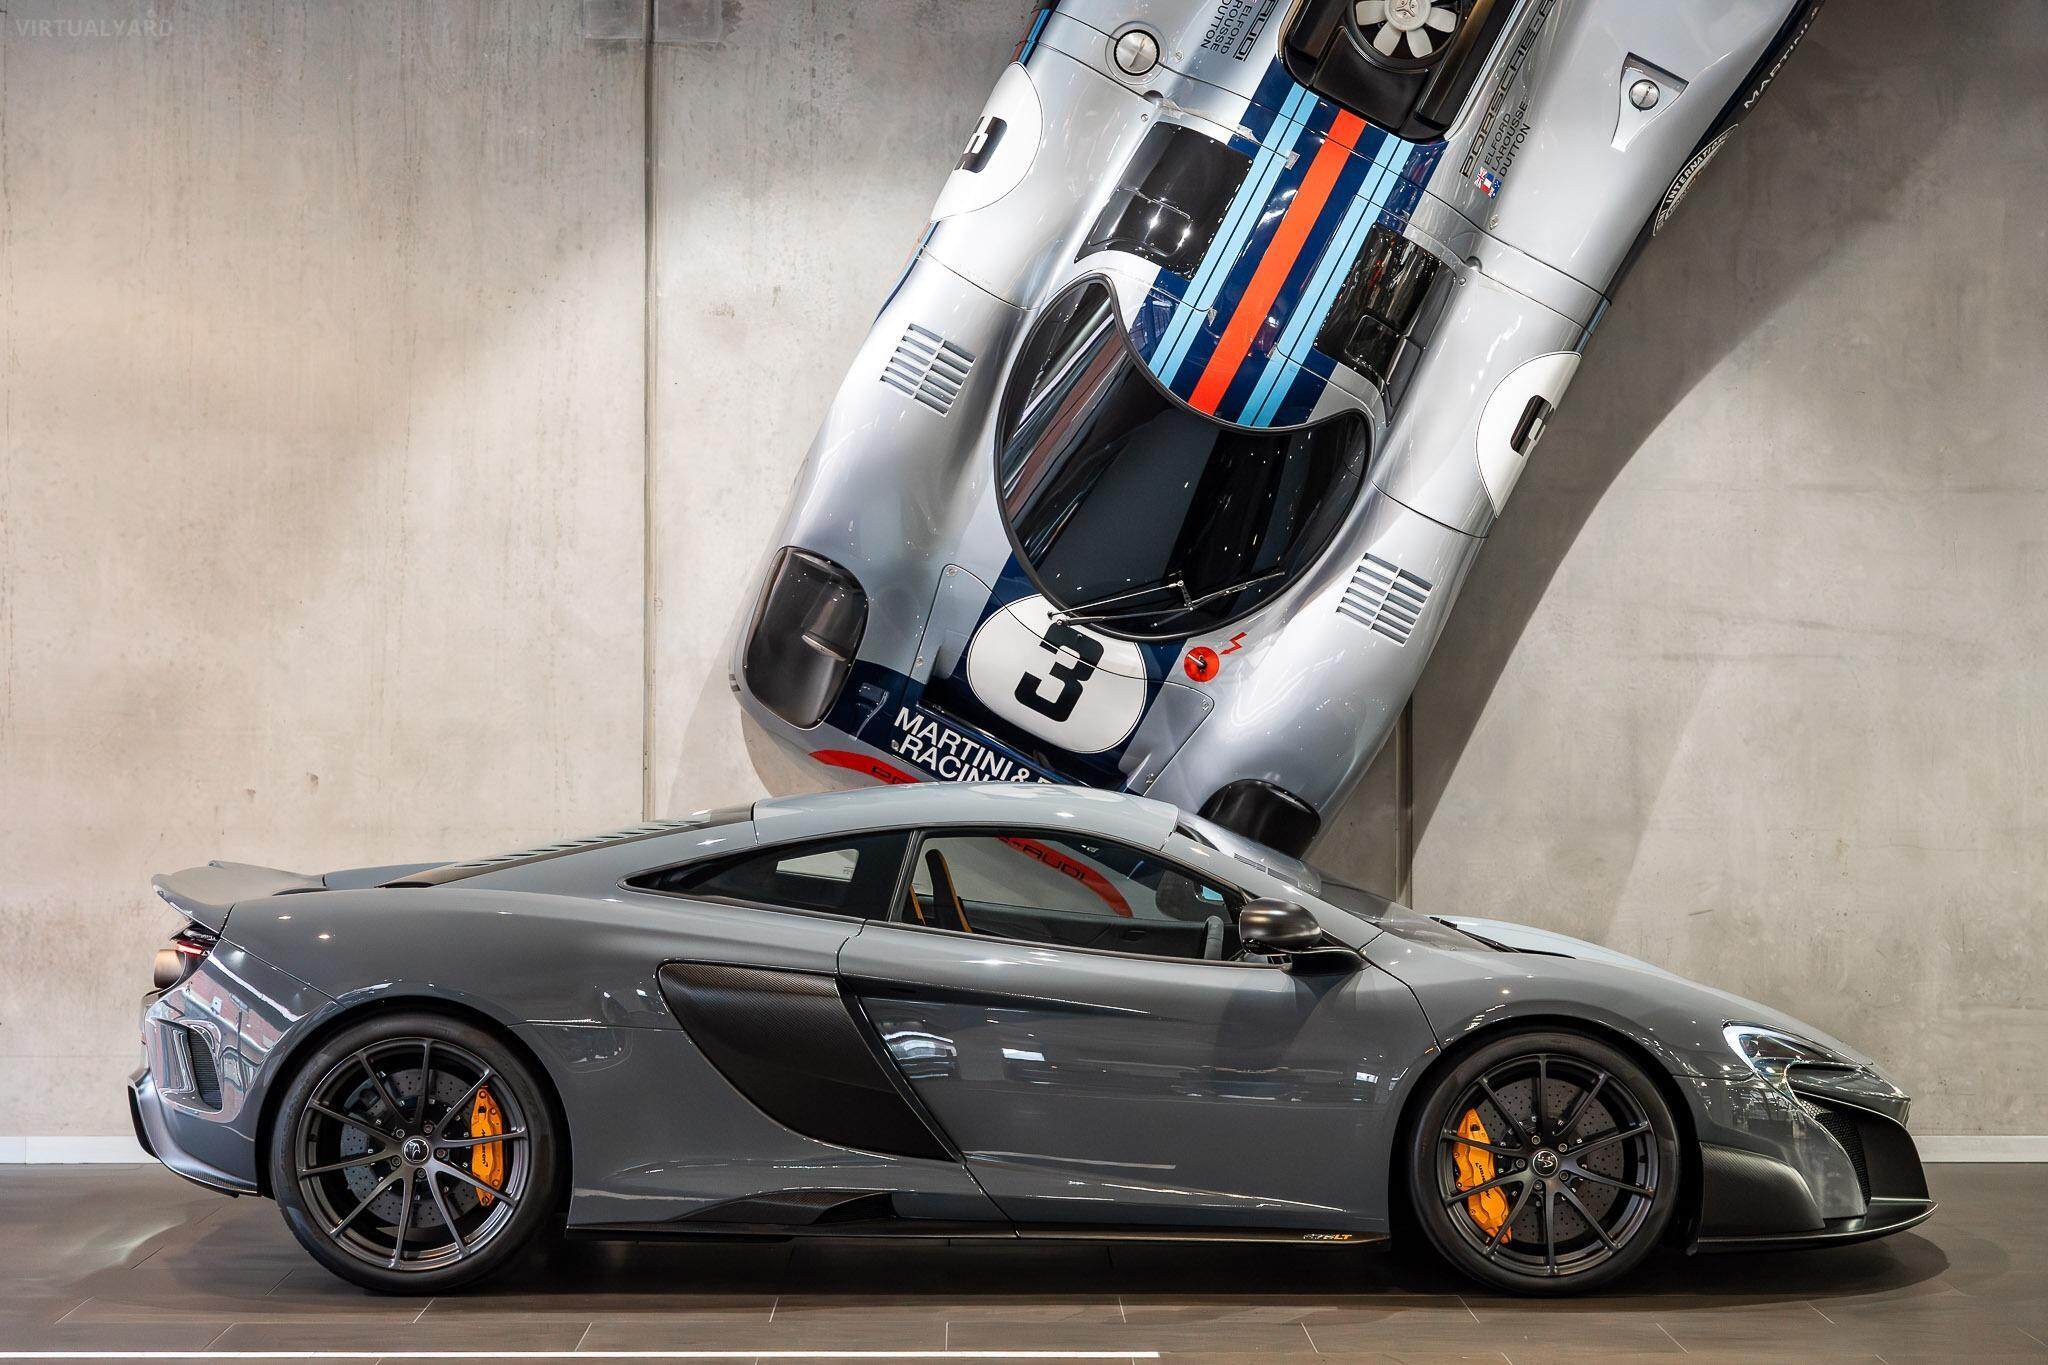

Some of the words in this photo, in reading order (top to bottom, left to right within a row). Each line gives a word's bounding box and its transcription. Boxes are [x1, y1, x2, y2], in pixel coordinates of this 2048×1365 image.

[1220, 5, 1252, 55] ELFORD
[1484, 112, 1511, 166] ELFORD
[1491, 101, 1528, 173] LAROUSSE
[1499, 122, 1531, 178] DUTTON
[1014, 621, 1105, 723] 3
[894, 707, 1013, 781] MARTINI
[900, 734, 991, 782] RACIN
